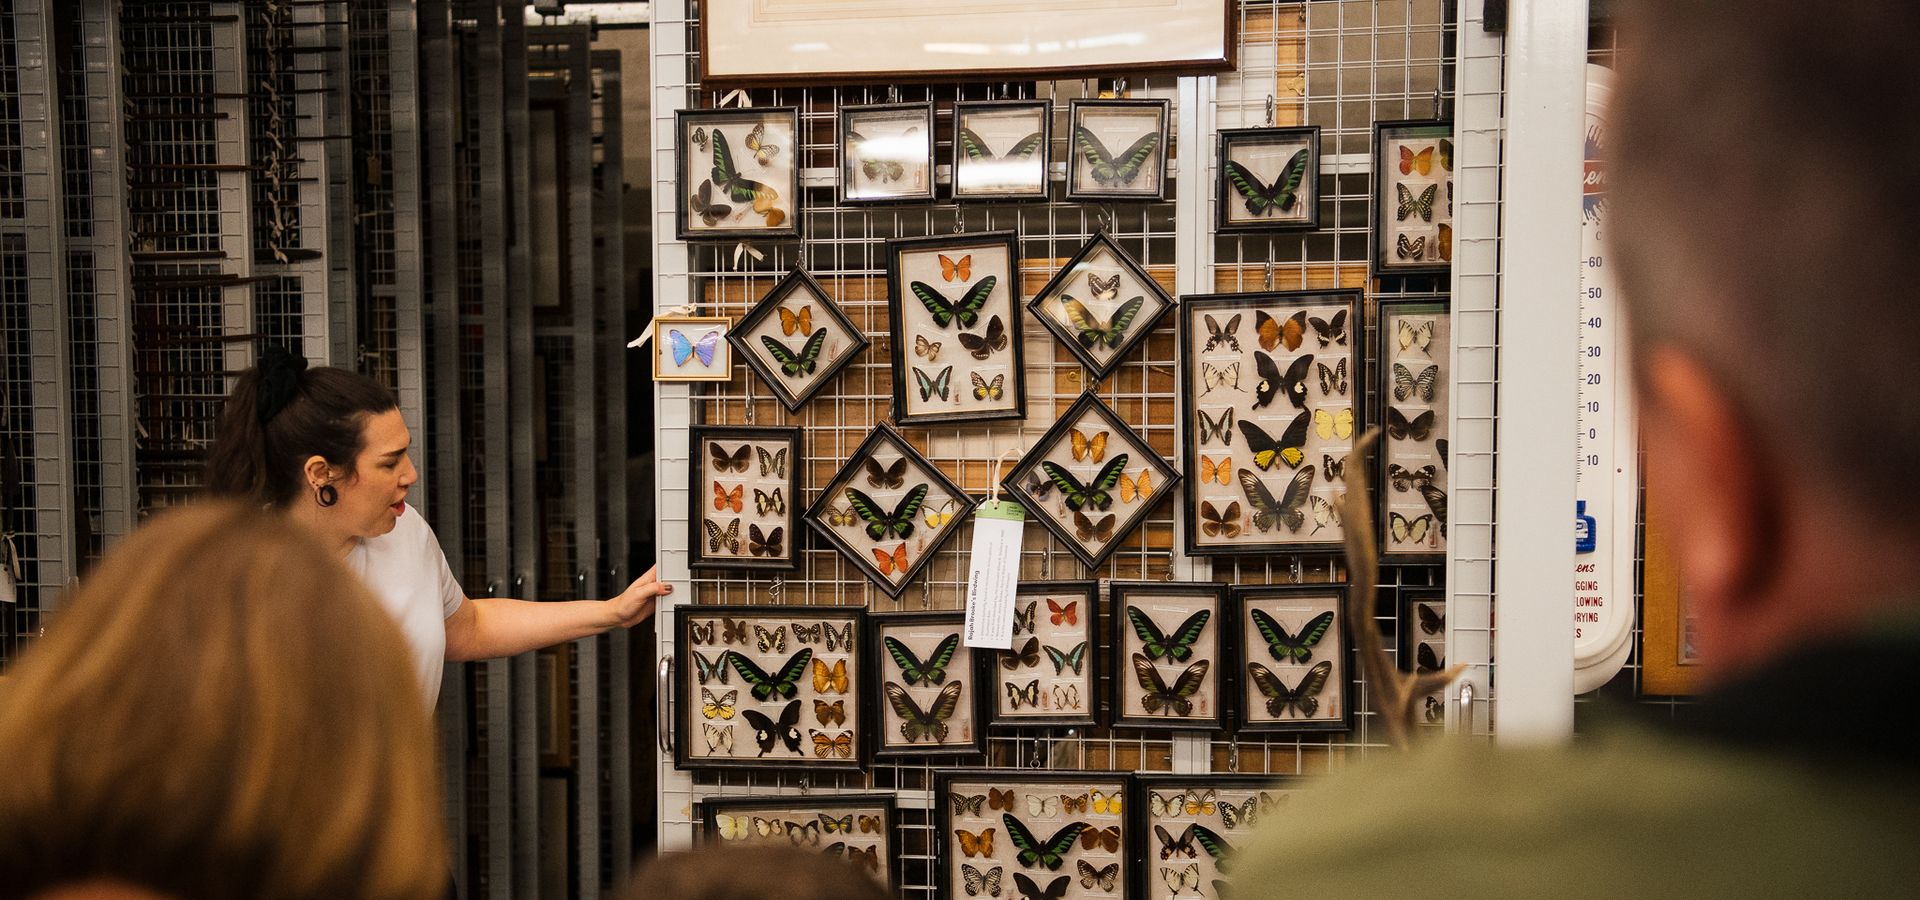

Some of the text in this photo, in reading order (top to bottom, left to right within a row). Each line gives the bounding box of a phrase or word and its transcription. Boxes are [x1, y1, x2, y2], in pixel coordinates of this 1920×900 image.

[1588, 256, 1602, 268] 60
[1588, 287, 1602, 299] 50
[1588, 317, 1602, 329] 40
[1587, 346, 1601, 358] 30
[1587, 374, 1601, 385] 20
[1587, 402, 1599, 413] 10
[1589, 428, 1596, 439] 0
[1587, 455, 1599, 466] 10
[1575, 563, 1595, 573] ens
[1575, 581, 1598, 591] GGING
[967, 570, 980, 641] Rajah Brooke's Birdwing
[1576, 597, 1603, 607] LOWING
